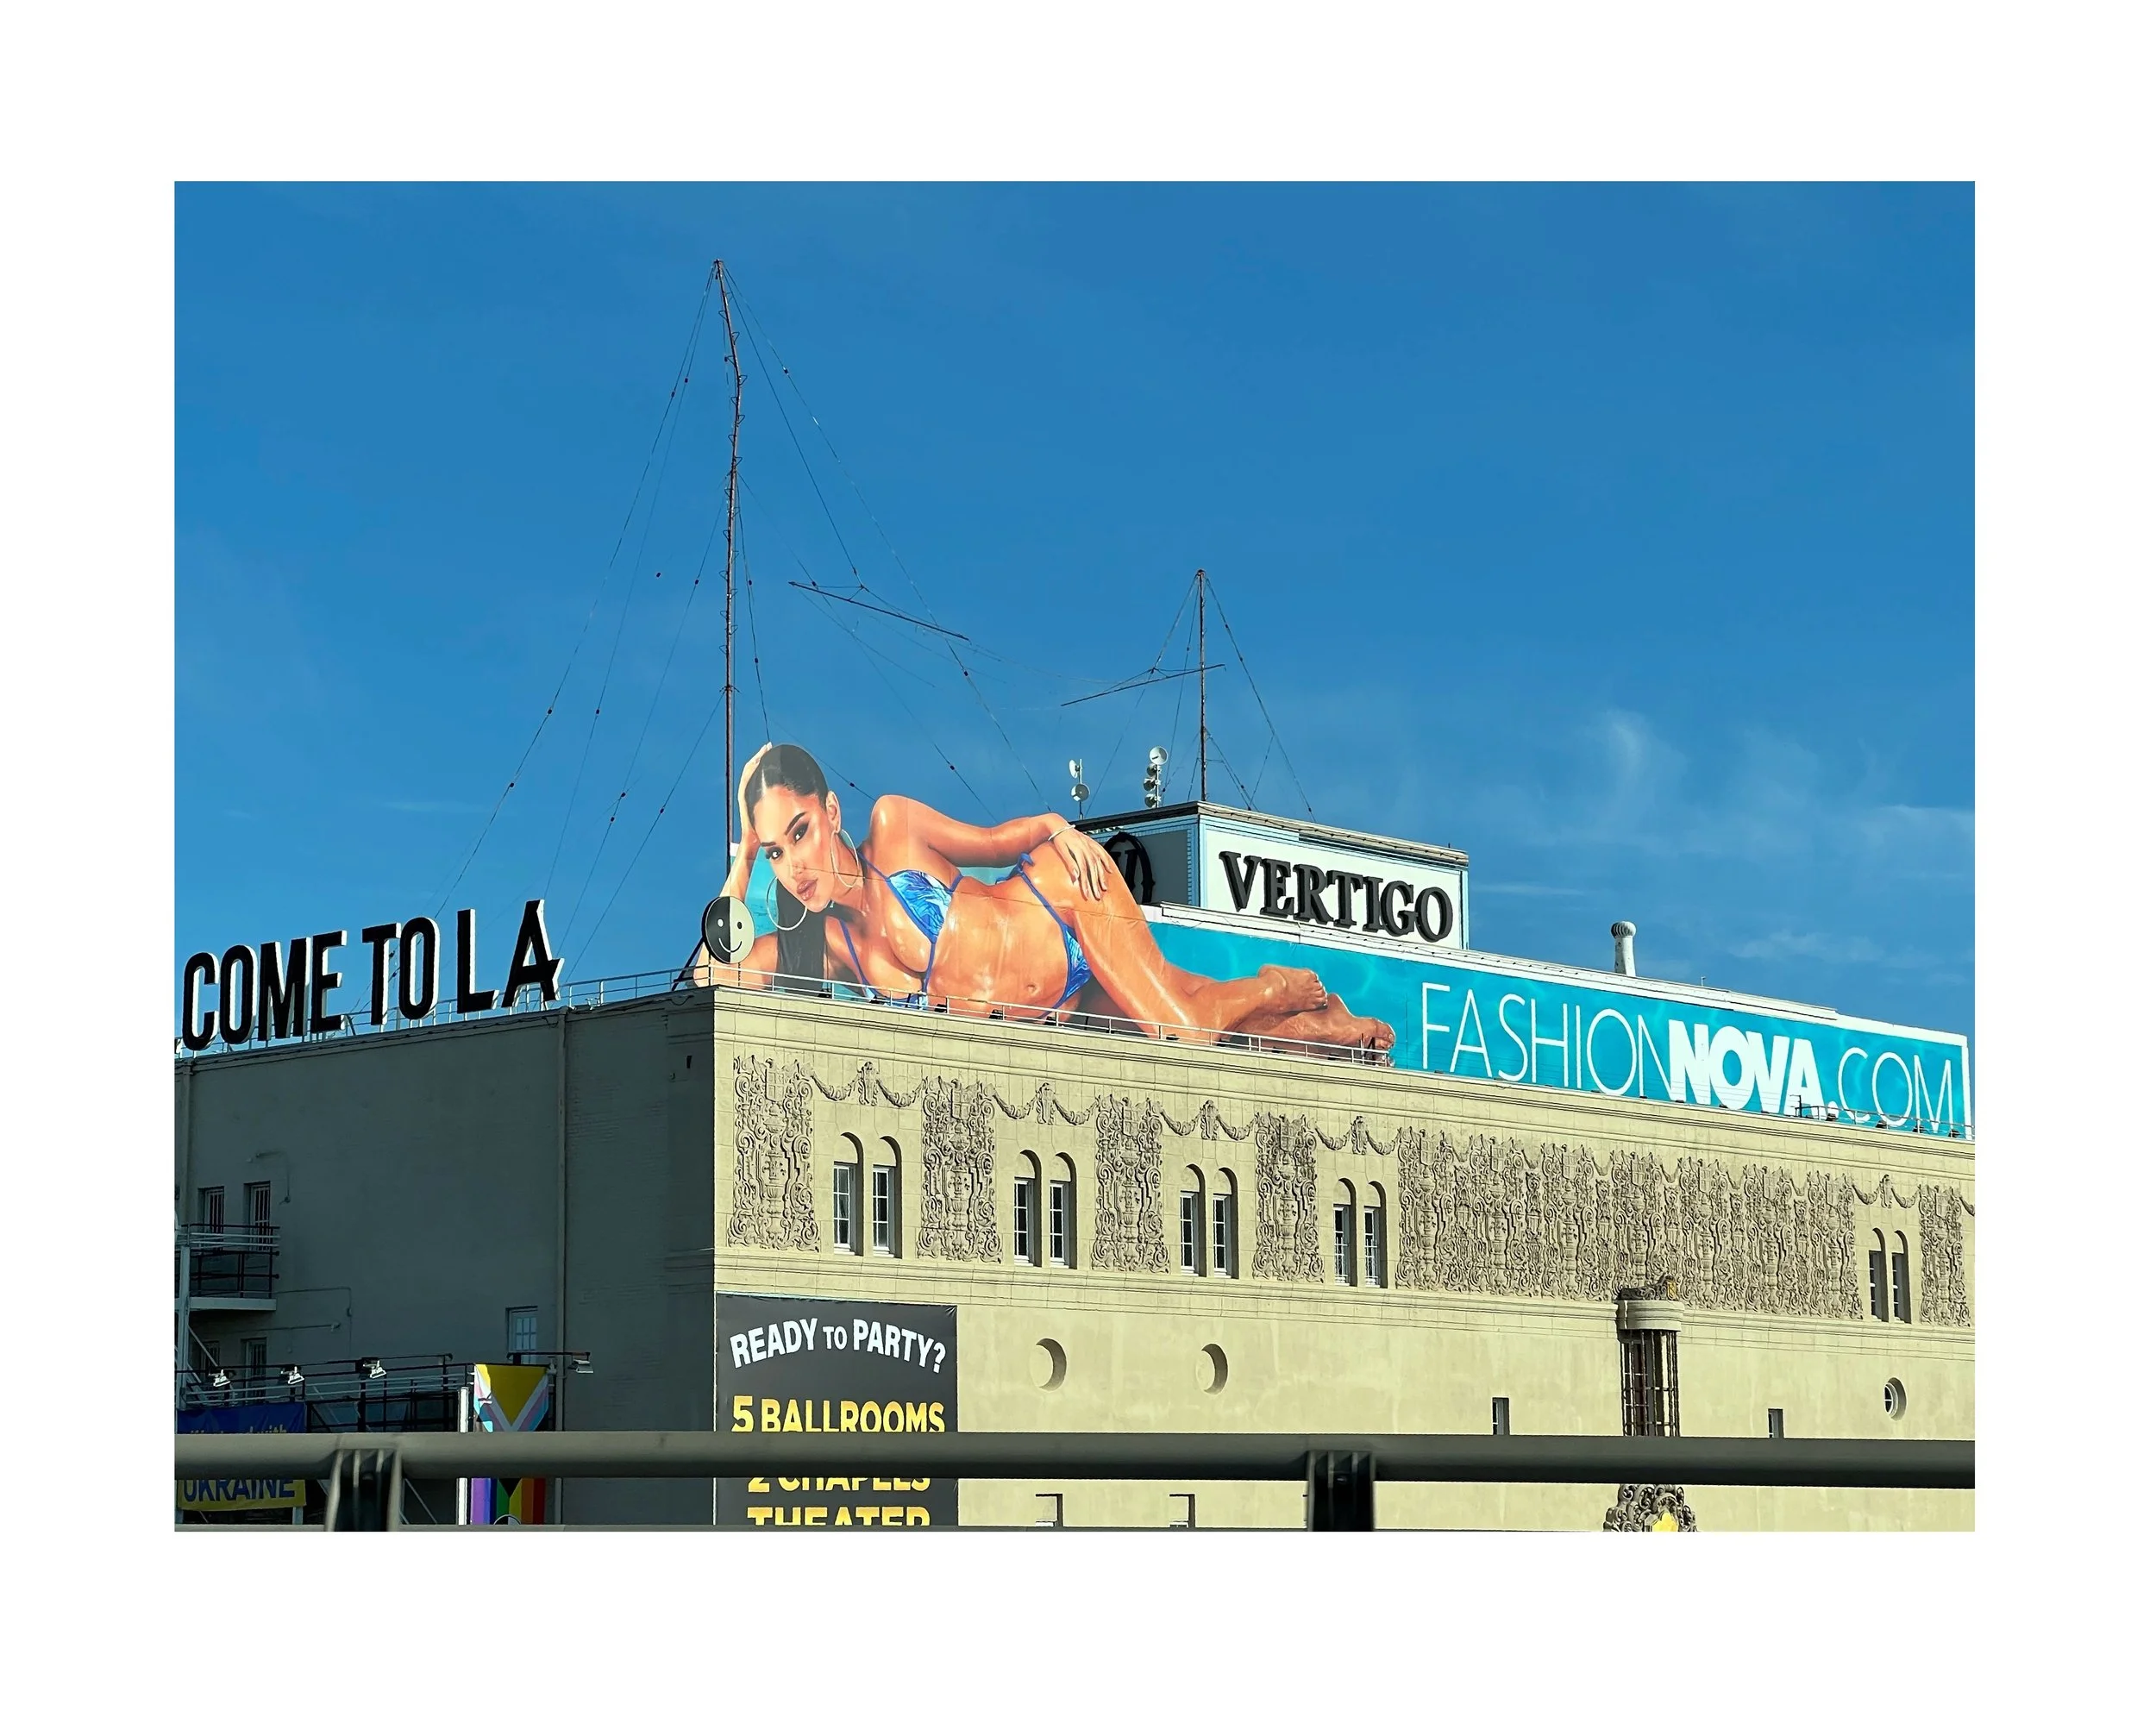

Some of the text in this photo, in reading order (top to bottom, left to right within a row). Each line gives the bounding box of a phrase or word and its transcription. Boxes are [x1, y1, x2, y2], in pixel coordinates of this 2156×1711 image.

[1219, 851, 1454, 943] VERTIGO
[183, 899, 564, 1050] COME TO LA
[730, 1318, 946, 1373] READY TO PARTY?
[731, 1395, 946, 1432] 5 BALLROOMS
